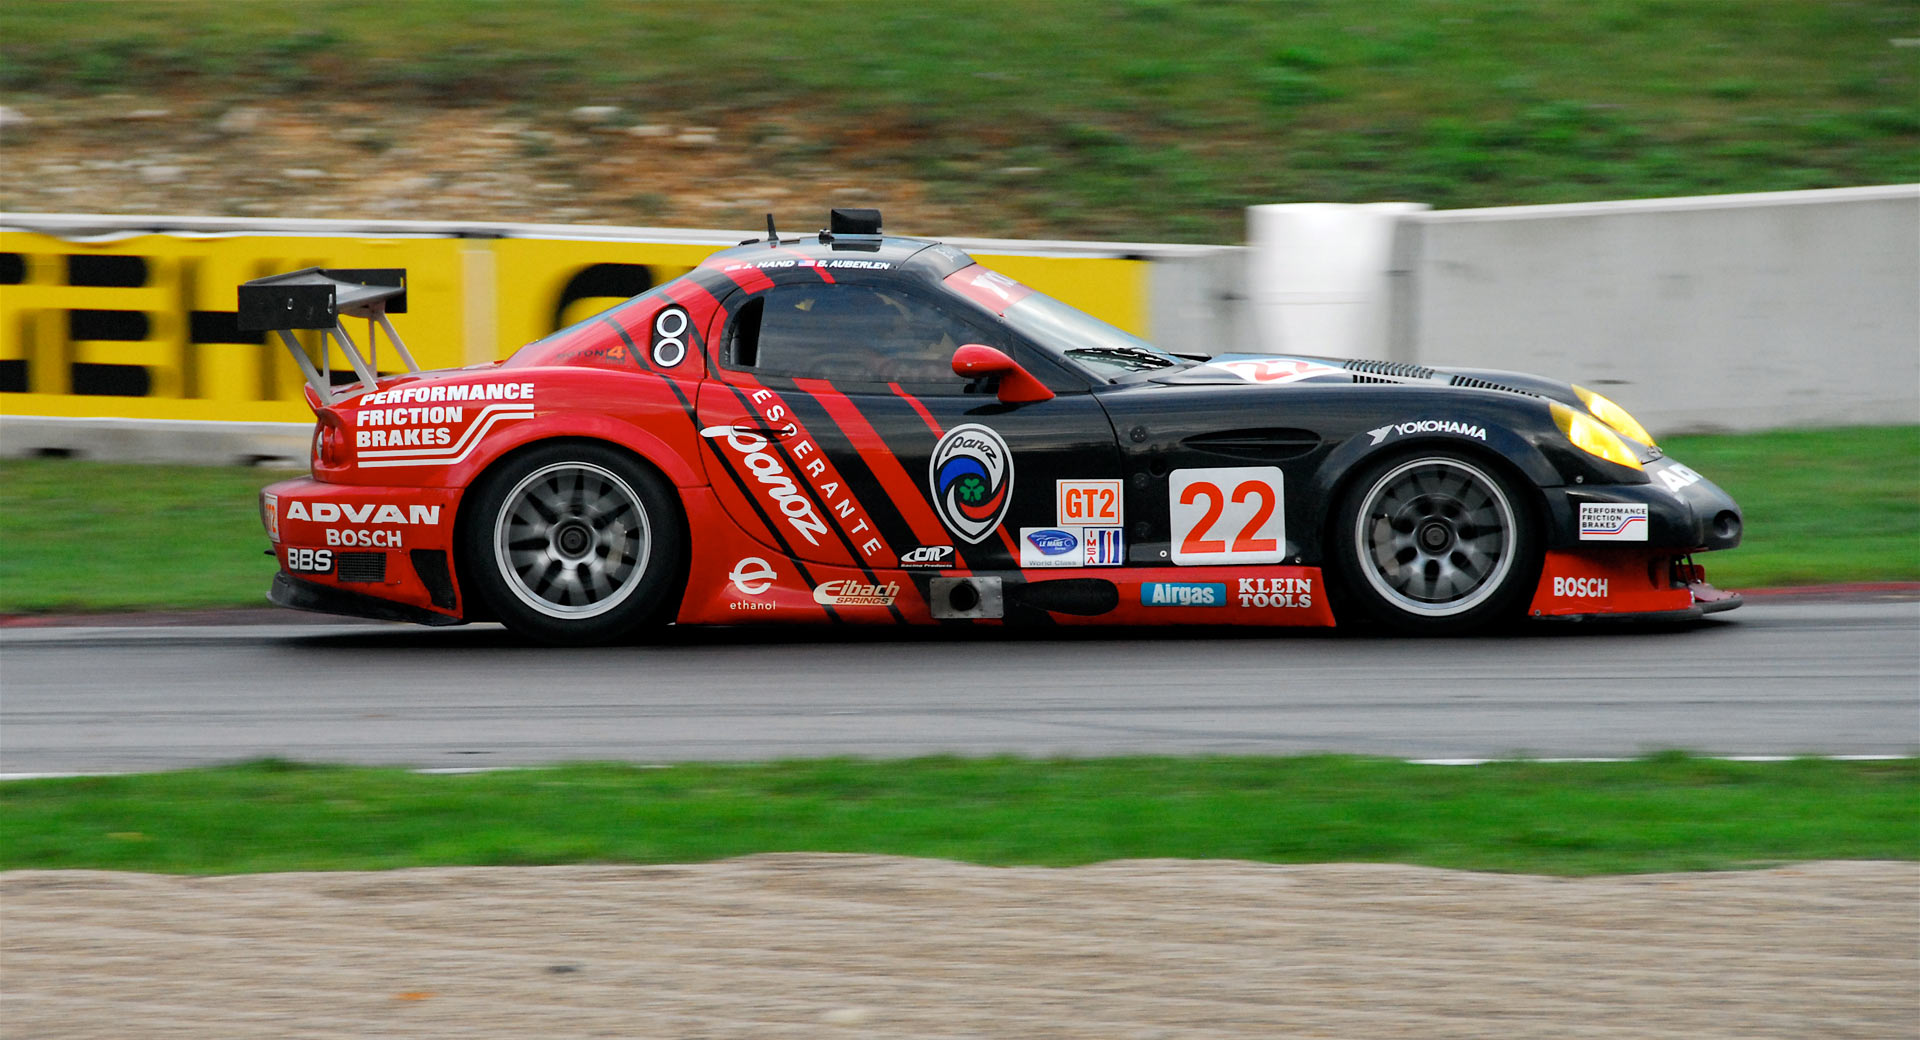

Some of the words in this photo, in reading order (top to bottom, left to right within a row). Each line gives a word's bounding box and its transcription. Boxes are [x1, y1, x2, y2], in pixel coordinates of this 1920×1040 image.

[757, 260, 795, 269] HAND
[829, 260, 890, 270] AUBERLEN
[360, 383, 535, 406] PERFORMANCE
[357, 406, 463, 427] FRICTION
[356, 427, 451, 448] BRAKES
[1394, 420, 1487, 441] YOKOHAMA
[752, 389, 882, 557] ESPERANTE
[286, 501, 440, 525] ADVAN
[1065, 488, 1115, 518] GT2
[1582, 507, 1647, 515] PERFORMANCE
[1179, 480, 1277, 554] 22
[1582, 521, 1617, 529] BRAKES
[325, 528, 402, 547] BOSCH
[287, 548, 332, 571] BBS
[1152, 583, 1215, 605] Airgas
[1238, 578, 1312, 594] KLEIN
[1553, 577, 1608, 597] BOSCH
[729, 601, 776, 610] ethanol
[835, 597, 890, 605] SPRINGS
[1238, 594, 1312, 608] TOOLS
